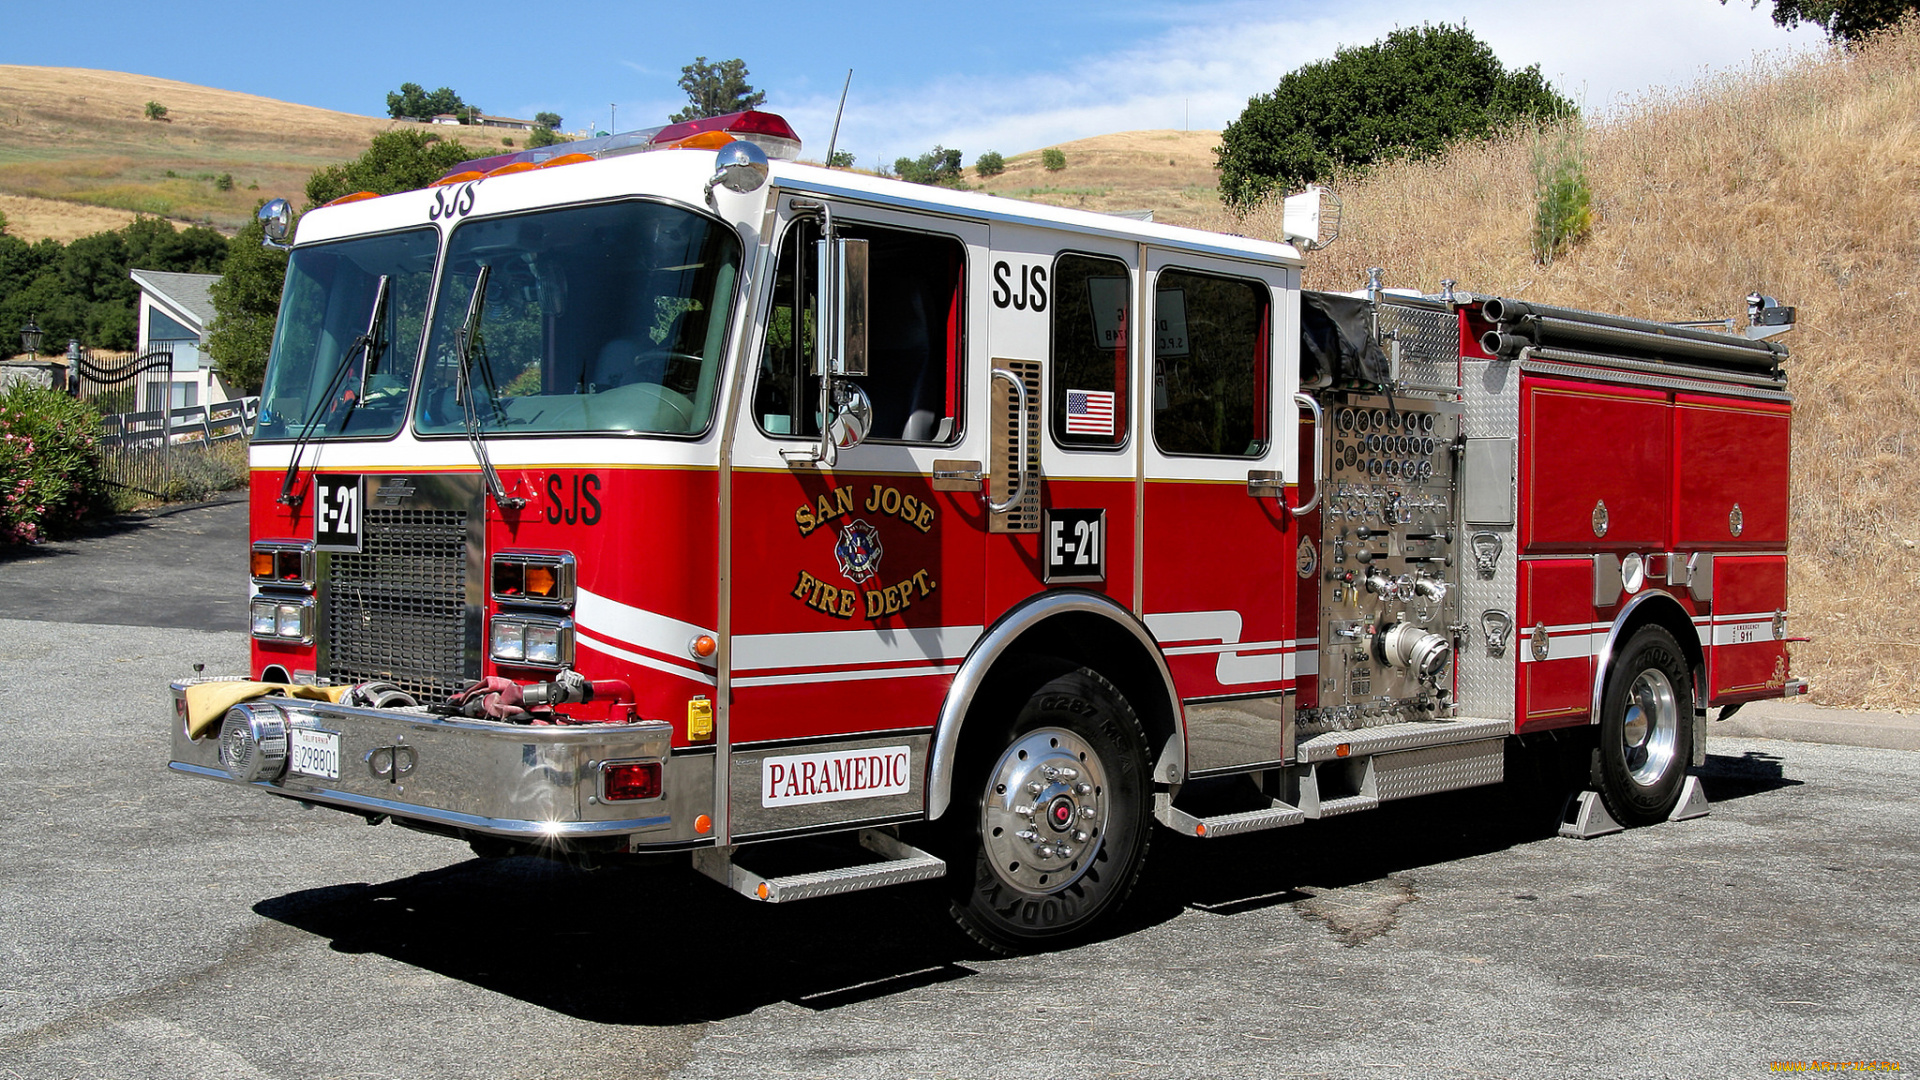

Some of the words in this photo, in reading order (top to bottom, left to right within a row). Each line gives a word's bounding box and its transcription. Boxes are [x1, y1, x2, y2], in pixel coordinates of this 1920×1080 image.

[429, 180, 484, 221] SJS
[993, 261, 1047, 312] SJS
[318, 486, 357, 534] E-21
[547, 473, 601, 526] SJS
[795, 485, 854, 537] SAN
[865, 484, 935, 533] JOSE
[1051, 520, 1098, 565] E-21
[791, 570, 856, 620] FIRE
[865, 568, 936, 620] DEPT.
[1740, 631, 1752, 642] 911
[301, 745, 338, 773] 298801
[769, 753, 907, 798] PARAMEDIC
